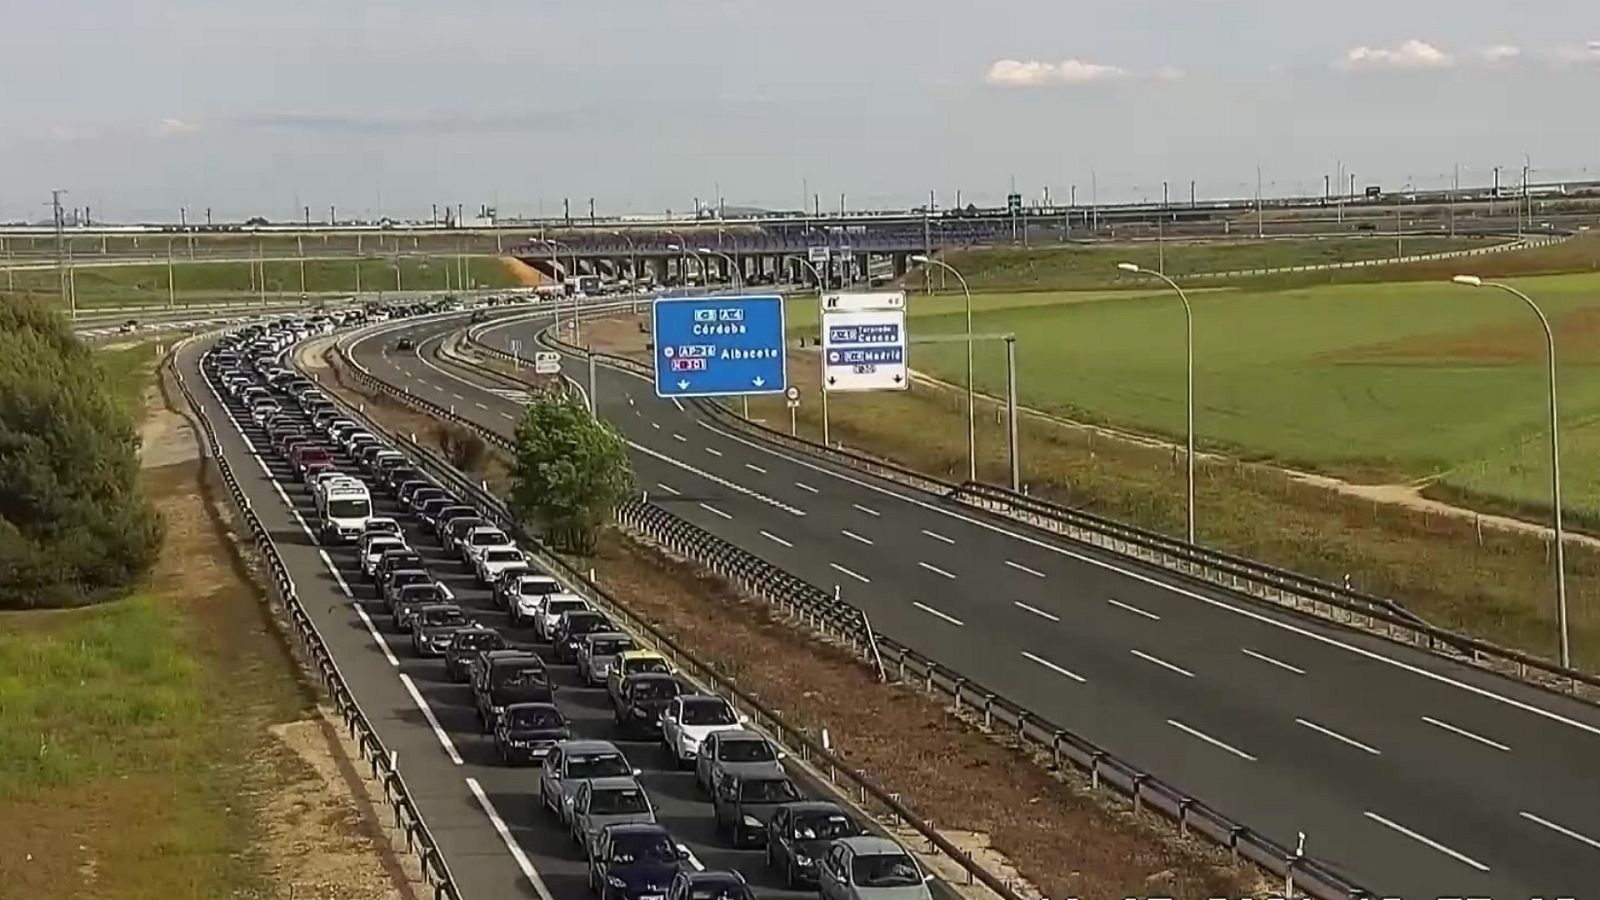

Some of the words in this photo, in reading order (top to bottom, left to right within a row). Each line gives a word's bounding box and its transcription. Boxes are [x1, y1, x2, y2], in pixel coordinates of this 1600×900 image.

[693, 323, 746, 335] Córdoba
[721, 348, 778, 359] Albacete
[865, 350, 900, 360] Madrid
